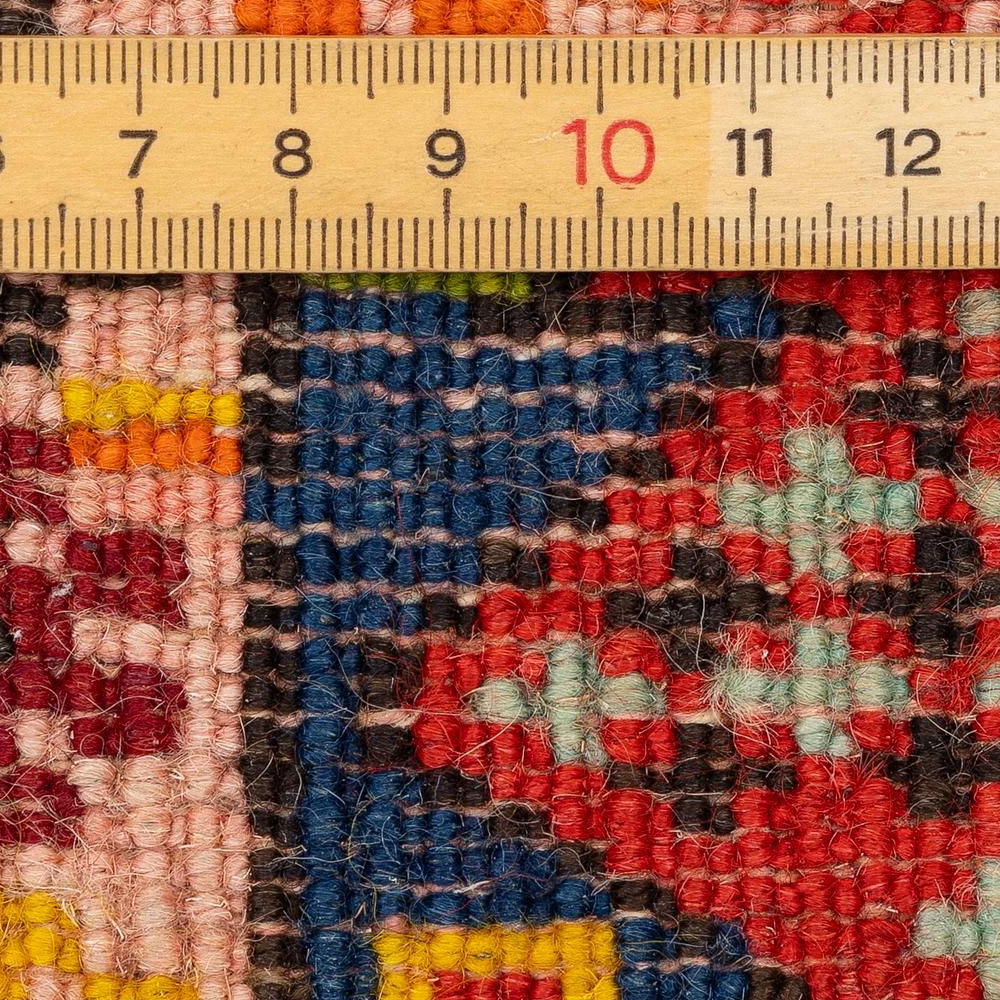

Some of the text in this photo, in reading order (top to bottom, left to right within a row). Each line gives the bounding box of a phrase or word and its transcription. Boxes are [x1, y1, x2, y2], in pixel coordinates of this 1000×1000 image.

[118, 129, 158, 179] 7
[272, 127, 313, 180] 8
[424, 127, 467, 180] 9
[561, 118, 656, 188] 10
[726, 127, 773, 178] 11
[875, 127, 942, 178] 12
